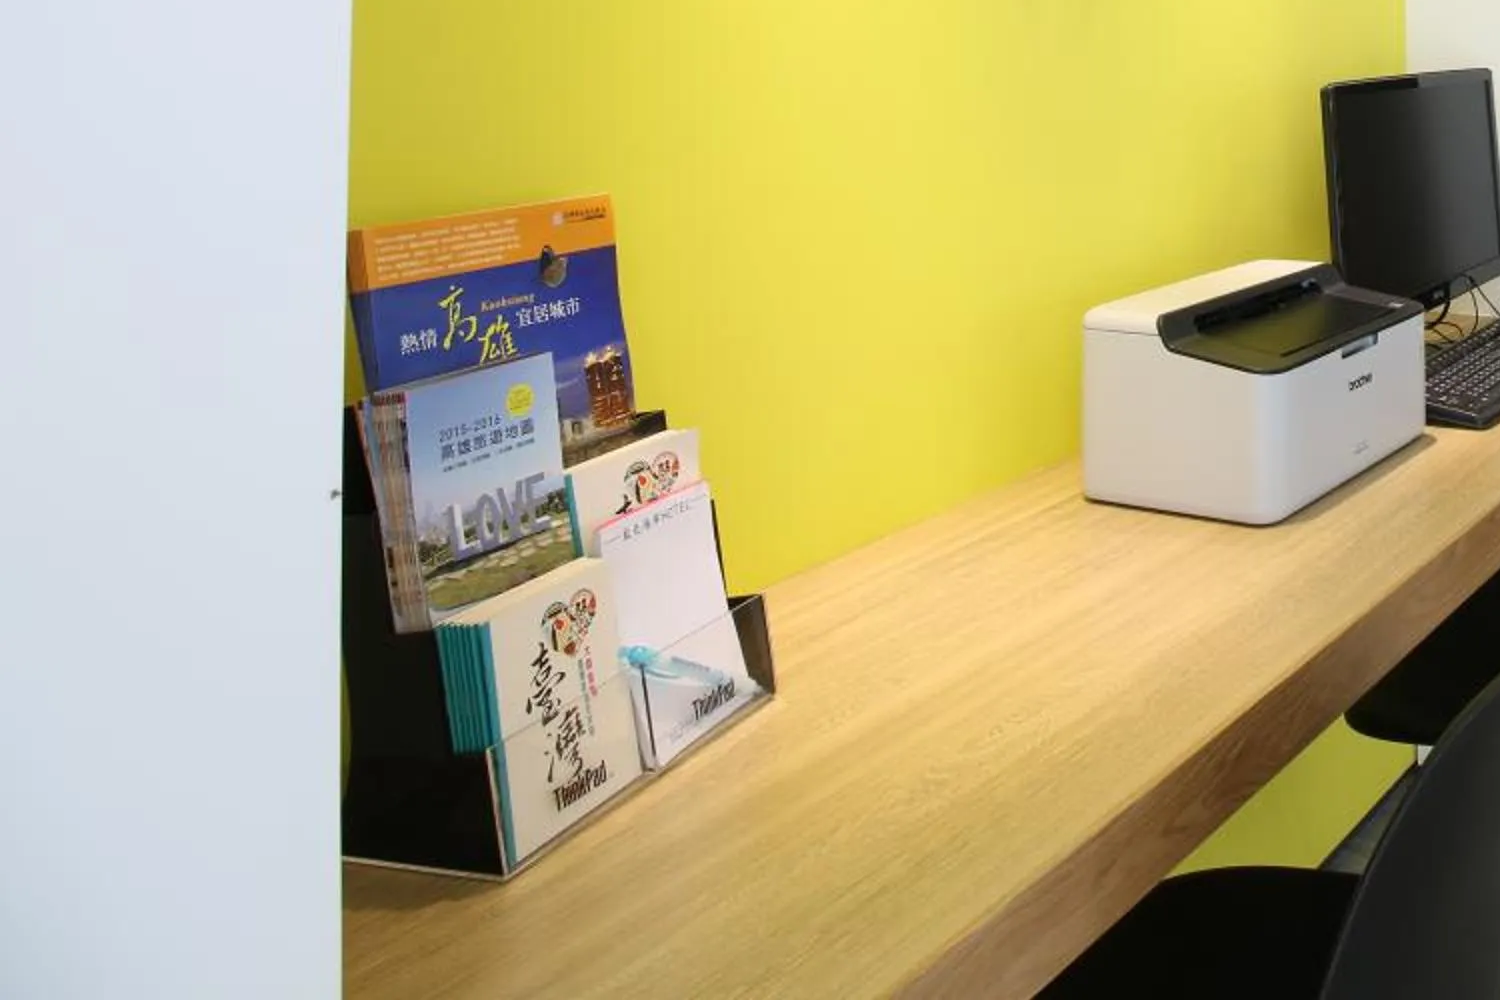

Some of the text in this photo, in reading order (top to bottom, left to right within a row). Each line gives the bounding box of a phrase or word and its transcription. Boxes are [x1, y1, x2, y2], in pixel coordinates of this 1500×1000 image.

[401, 327, 437, 355] 熱情
[437, 284, 518, 366] 高雄
[448, 472, 551, 560] LOVE
[553, 760, 607, 812] ThinkPad
